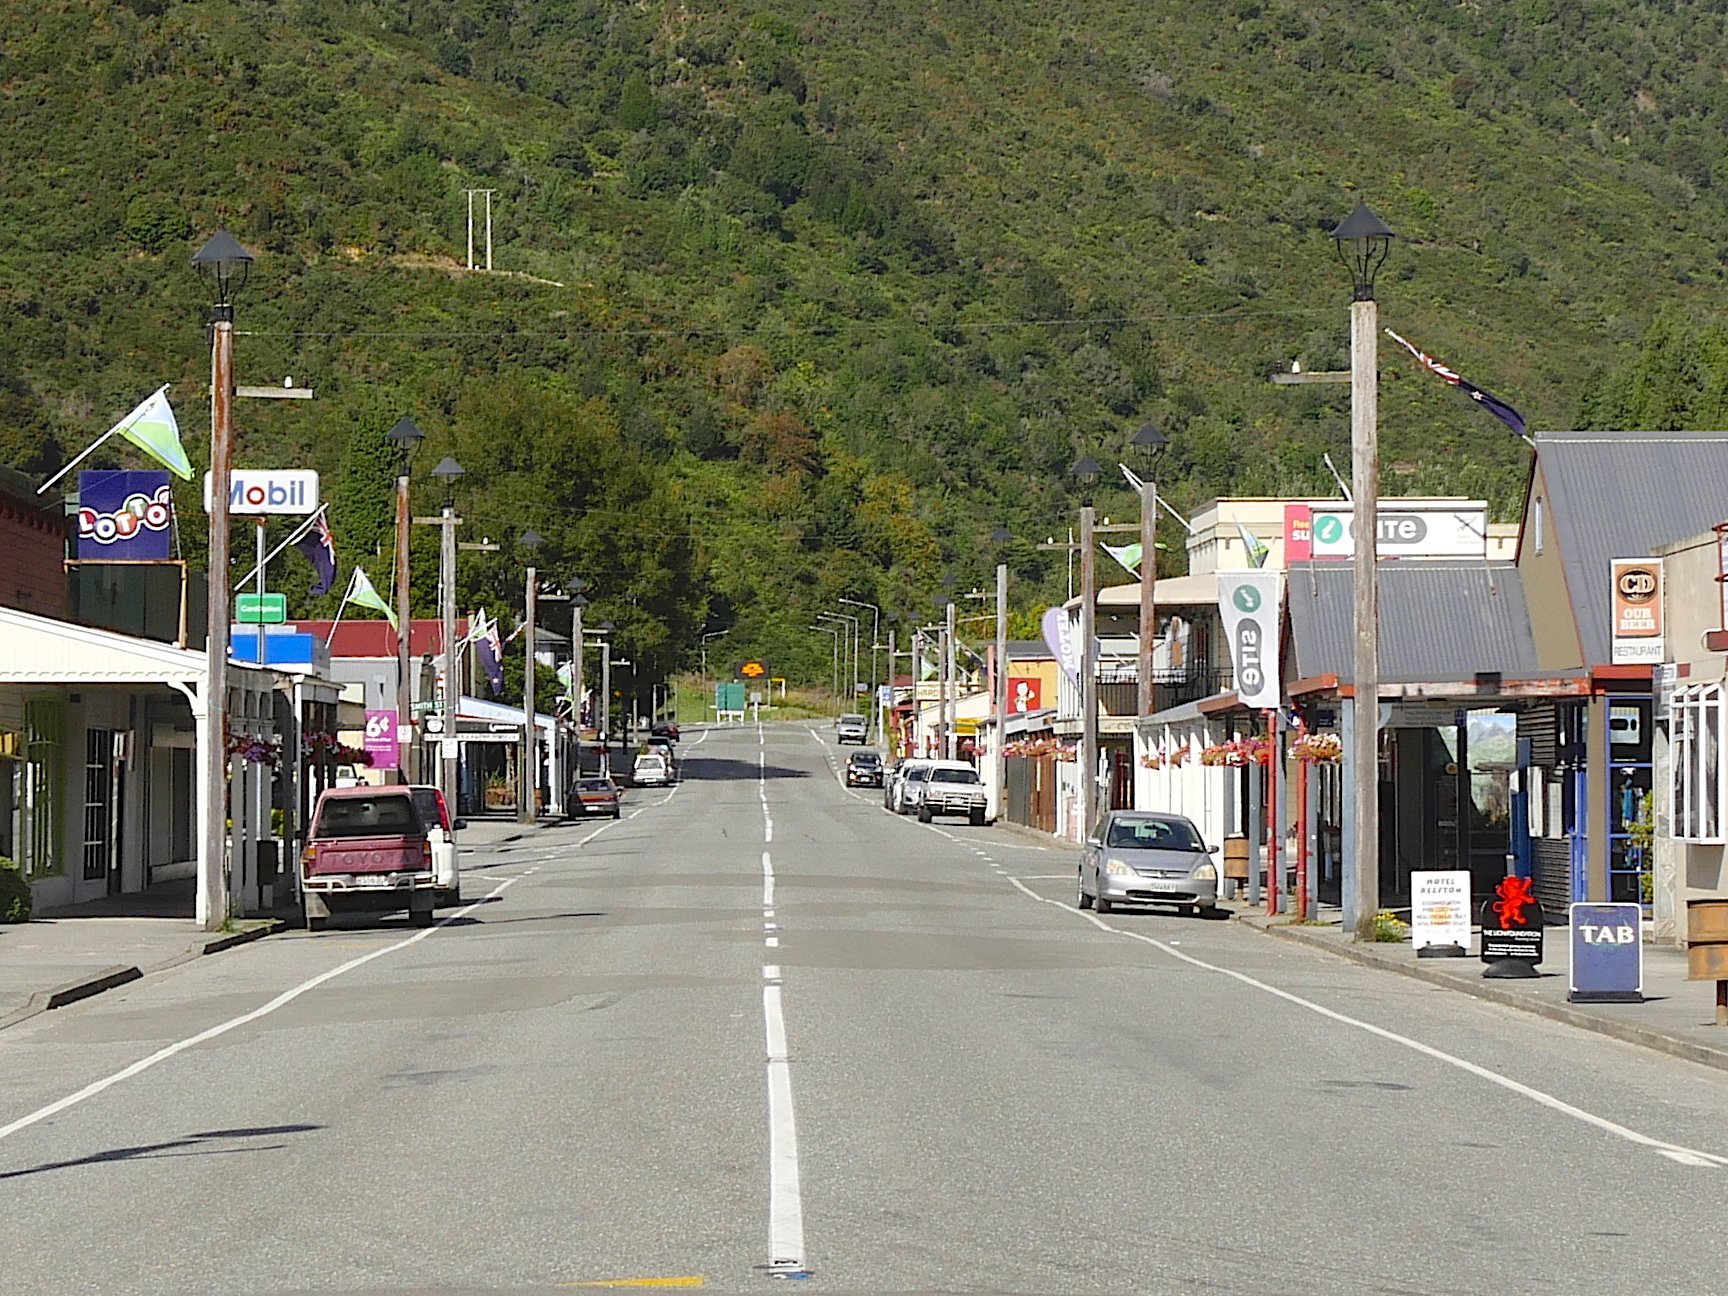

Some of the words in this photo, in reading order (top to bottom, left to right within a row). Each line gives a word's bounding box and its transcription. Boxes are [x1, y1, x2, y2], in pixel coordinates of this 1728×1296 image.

[230, 480, 305, 505] Mobil
[79, 498, 169, 540] LOTTO
[1620, 575, 1655, 594] CD
[1623, 608, 1651, 619] OUR
[1614, 645, 1662, 657] RESTAURANT
[1578, 925, 1634, 944] TAB
